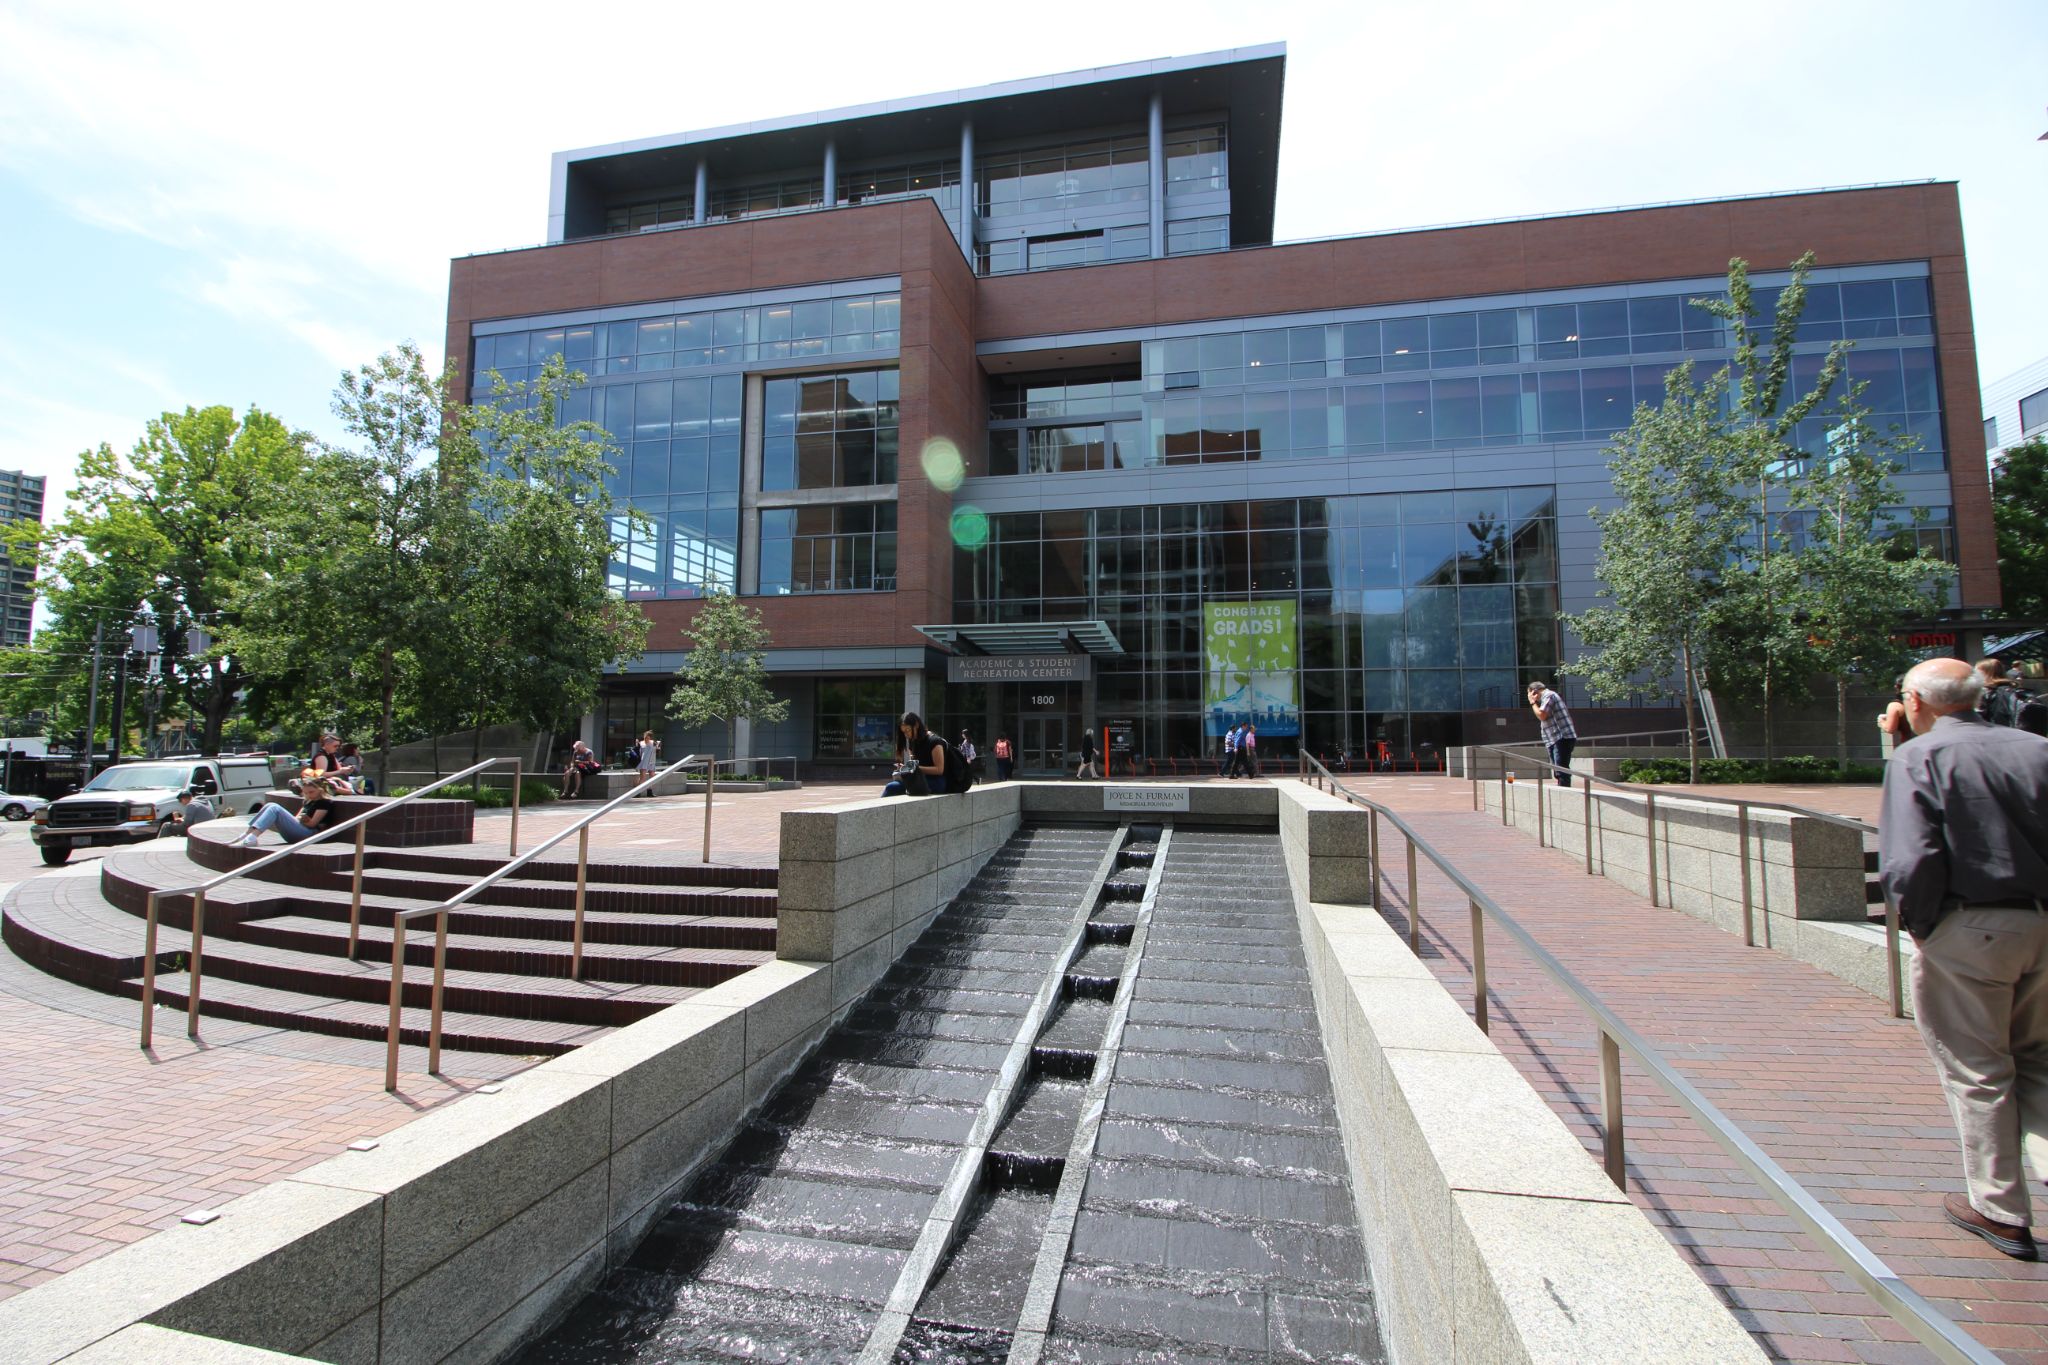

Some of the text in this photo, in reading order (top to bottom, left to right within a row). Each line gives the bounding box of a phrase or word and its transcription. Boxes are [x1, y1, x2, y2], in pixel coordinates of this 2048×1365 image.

[1214, 606, 1281, 617] CONGRATS
[1213, 619, 1282, 635] GRADS!
[960, 658, 1078, 668] ACADEMIC & STUDENT
[963, 668, 1073, 678] RECREATION CENTER
[1031, 695, 1055, 705] 1800
[1109, 792, 1133, 801] JOYCE
[1135, 792, 1144, 800] N.
